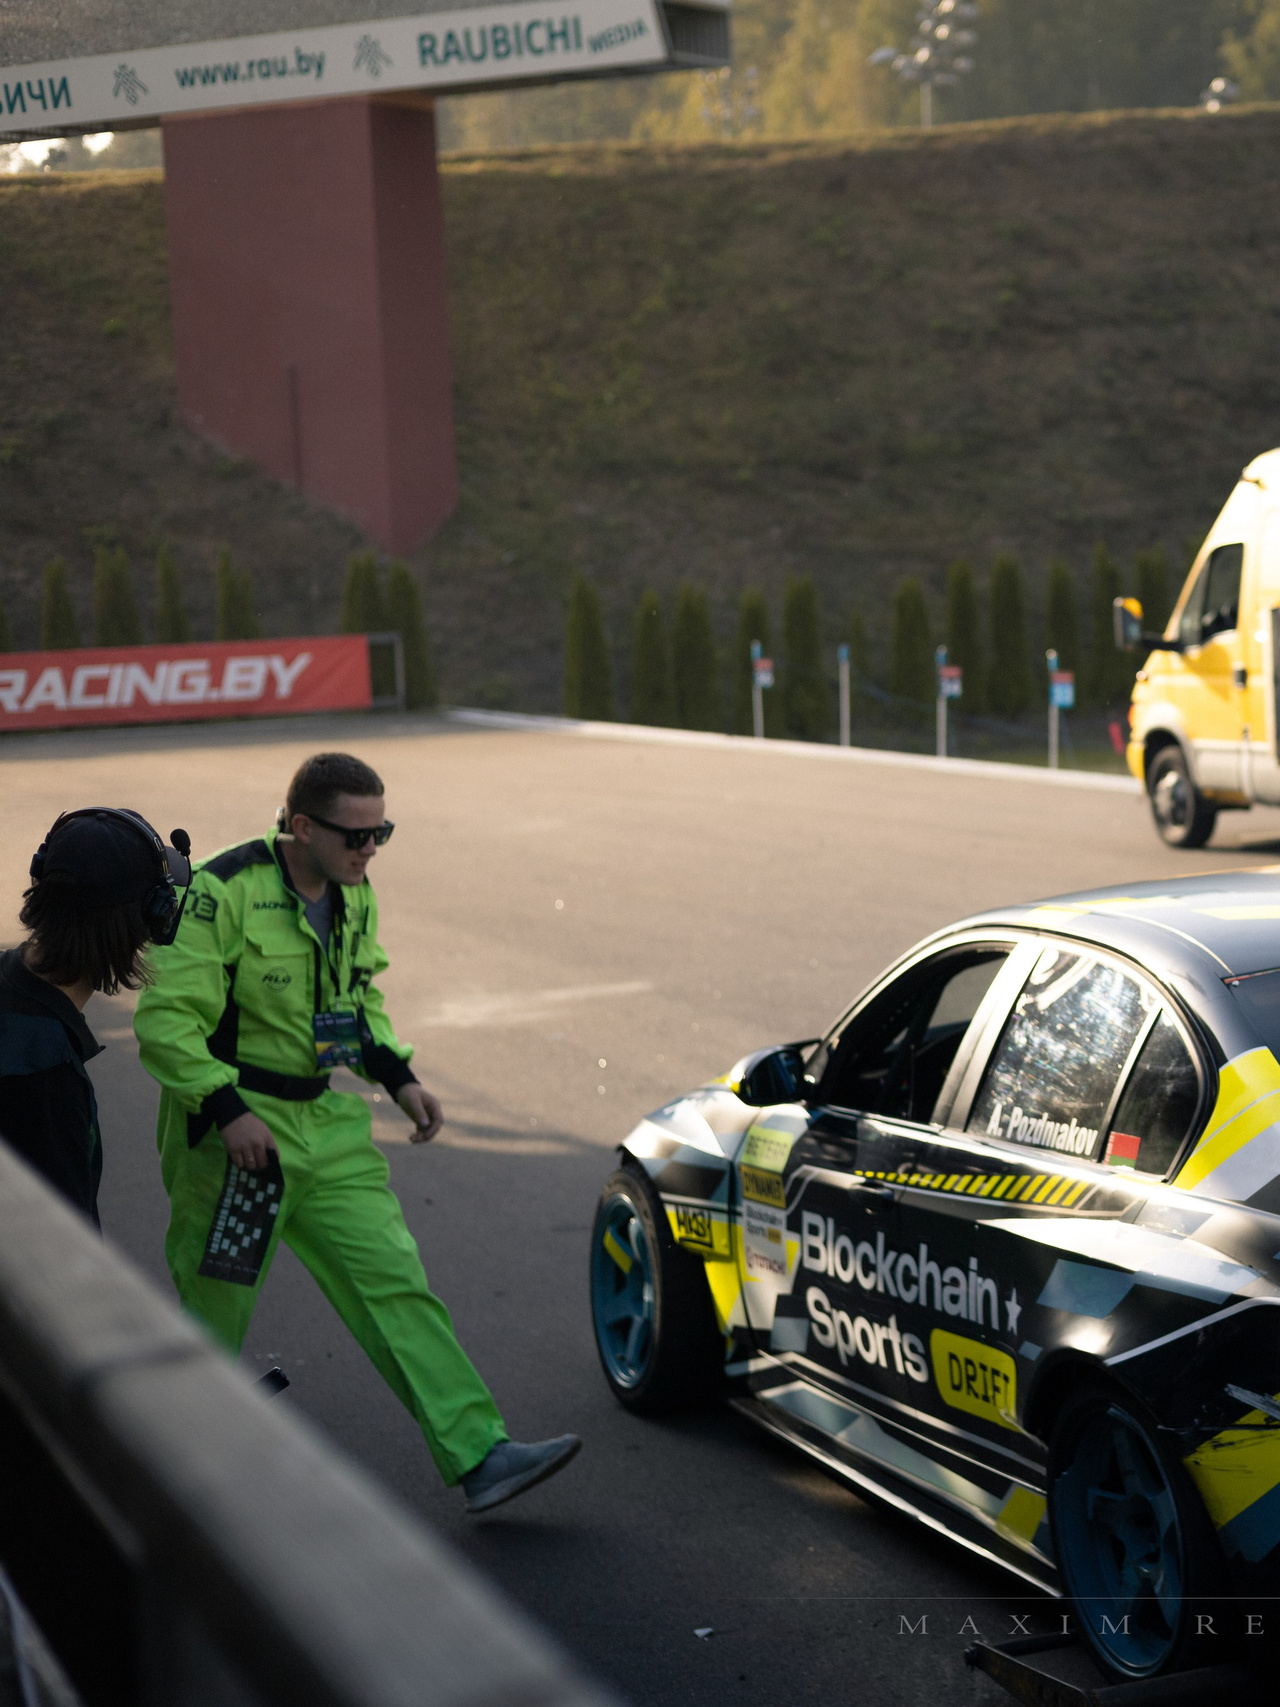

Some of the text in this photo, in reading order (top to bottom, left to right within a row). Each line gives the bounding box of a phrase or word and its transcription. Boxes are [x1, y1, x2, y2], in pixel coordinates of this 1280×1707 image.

[174, 46, 326, 88] www.rau.by
[418, 14, 582, 68] RAUBICHI
[0, 75, 72, 117] ИЧИ
[0, 652, 312, 713] RACING.BY
[985, 1103, 1098, 1156] A. Pozdniakov
[802, 1210, 999, 1331] Blockchain
[806, 1286, 929, 1384] Sports
[947, 1351, 1010, 1408] DRIFT
